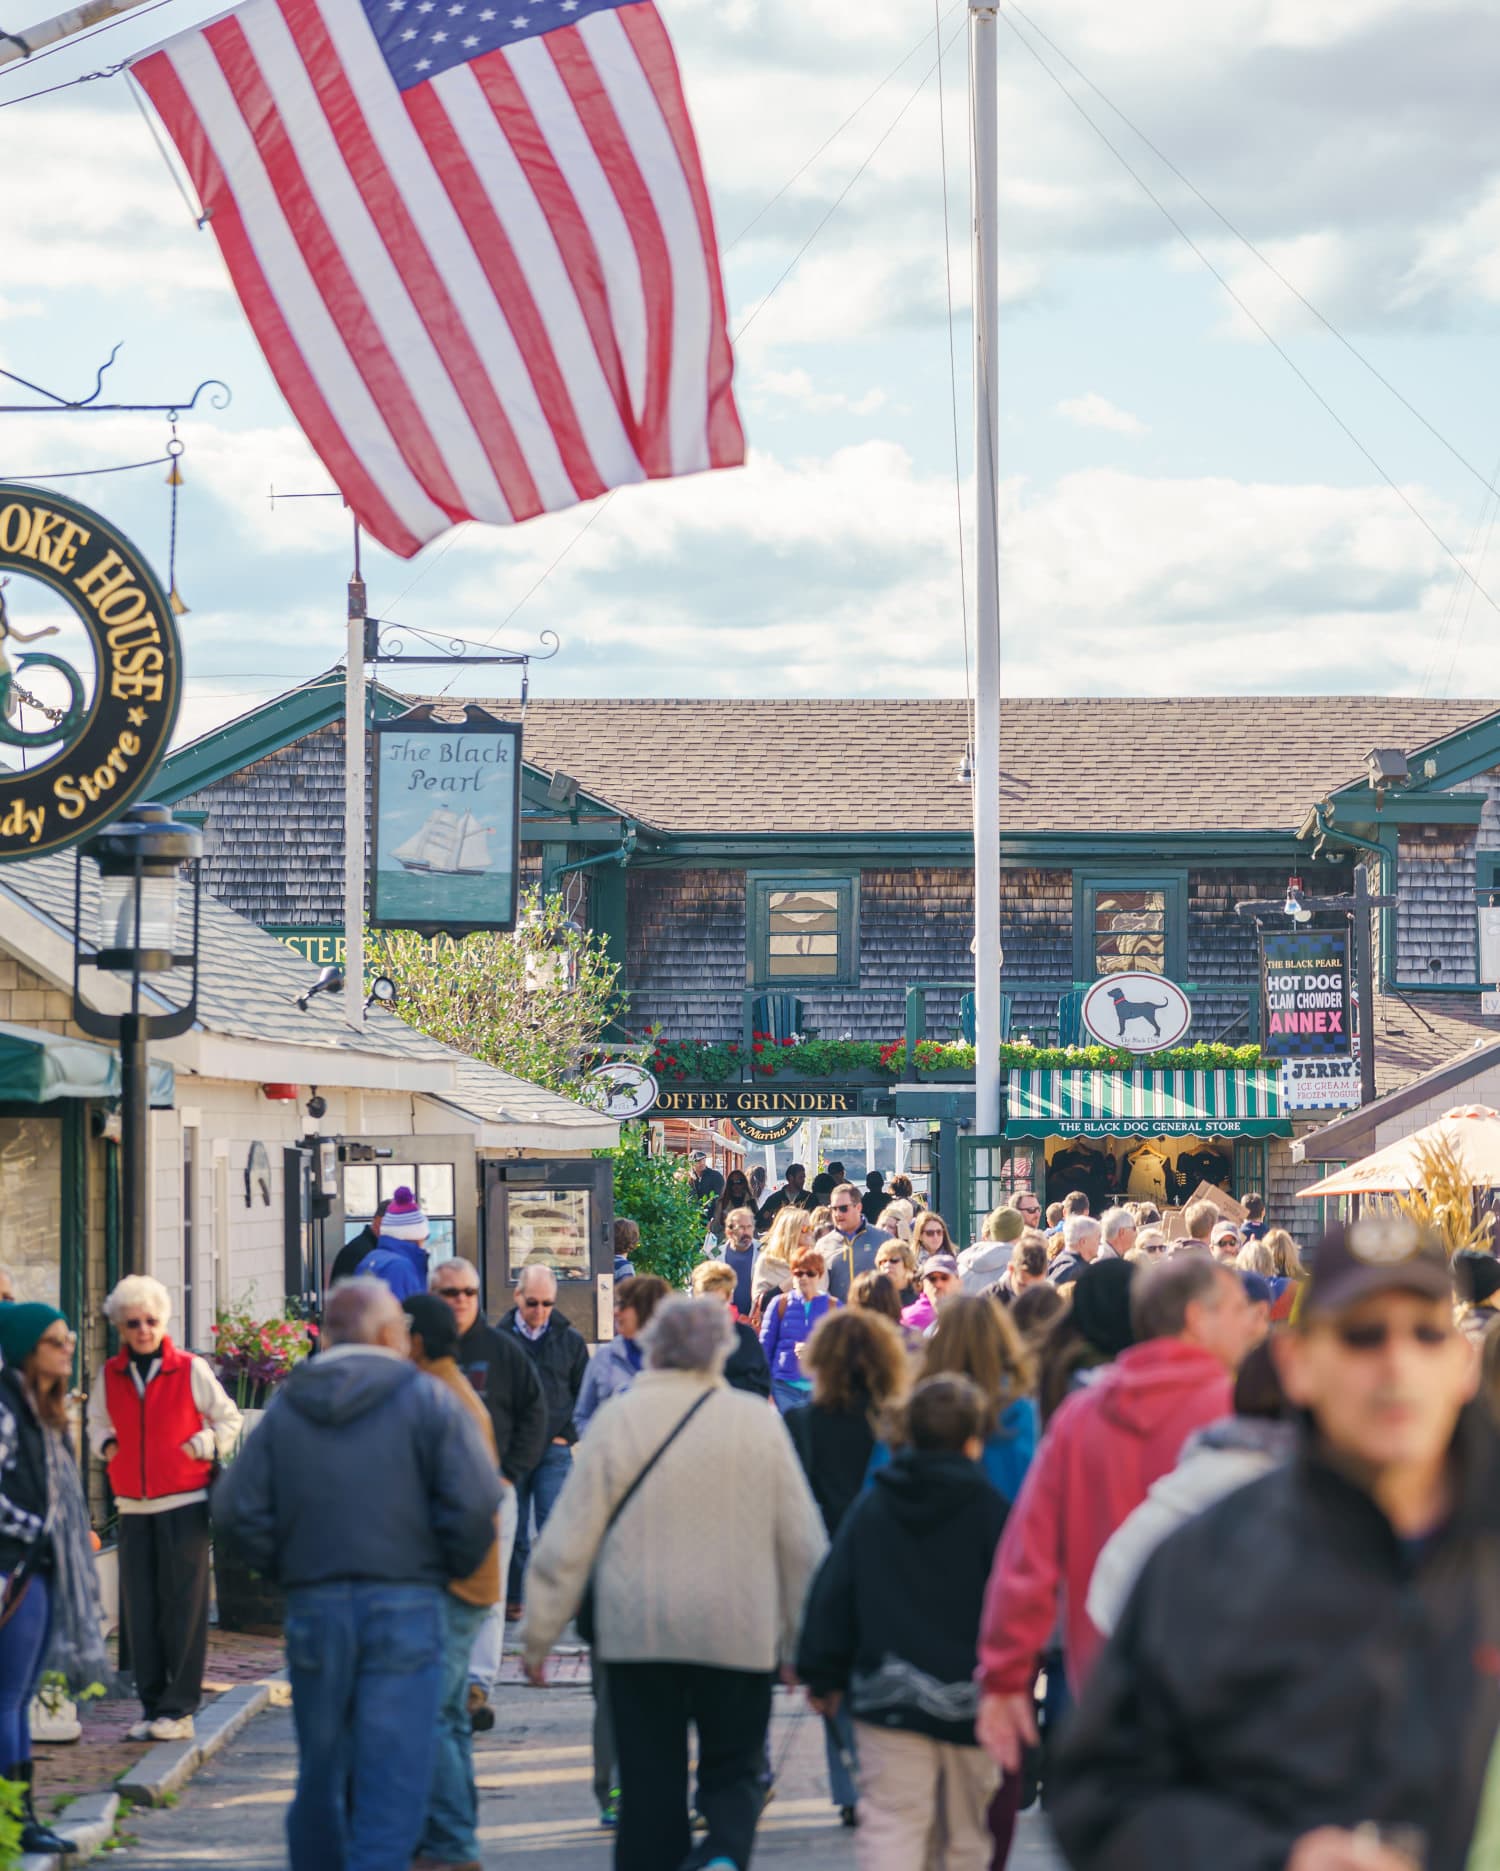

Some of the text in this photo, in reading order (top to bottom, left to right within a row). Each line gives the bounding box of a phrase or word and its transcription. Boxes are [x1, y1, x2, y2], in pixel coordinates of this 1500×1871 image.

[73, 548, 164, 702] HOUSE
[390, 737, 508, 763] The Black
[0, 730, 140, 843] dy Store
[408, 768, 484, 792] Pearl
[1267, 958, 1342, 969] THE BLACK PEARL
[1268, 974, 1342, 991] HOT DOG
[1268, 992, 1342, 1010] CLAM CHOWDER
[1269, 1011, 1342, 1034] ANNEX
[1297, 1082, 1312, 1091] ICE
[1315, 1081, 1349, 1090] CREAM
[653, 1092, 848, 1110] OFFEE GRINDER
[743, 1126, 787, 1140] Marina
[1059, 1122, 1241, 1131] THE BLACK DOG GENERAL STORE
